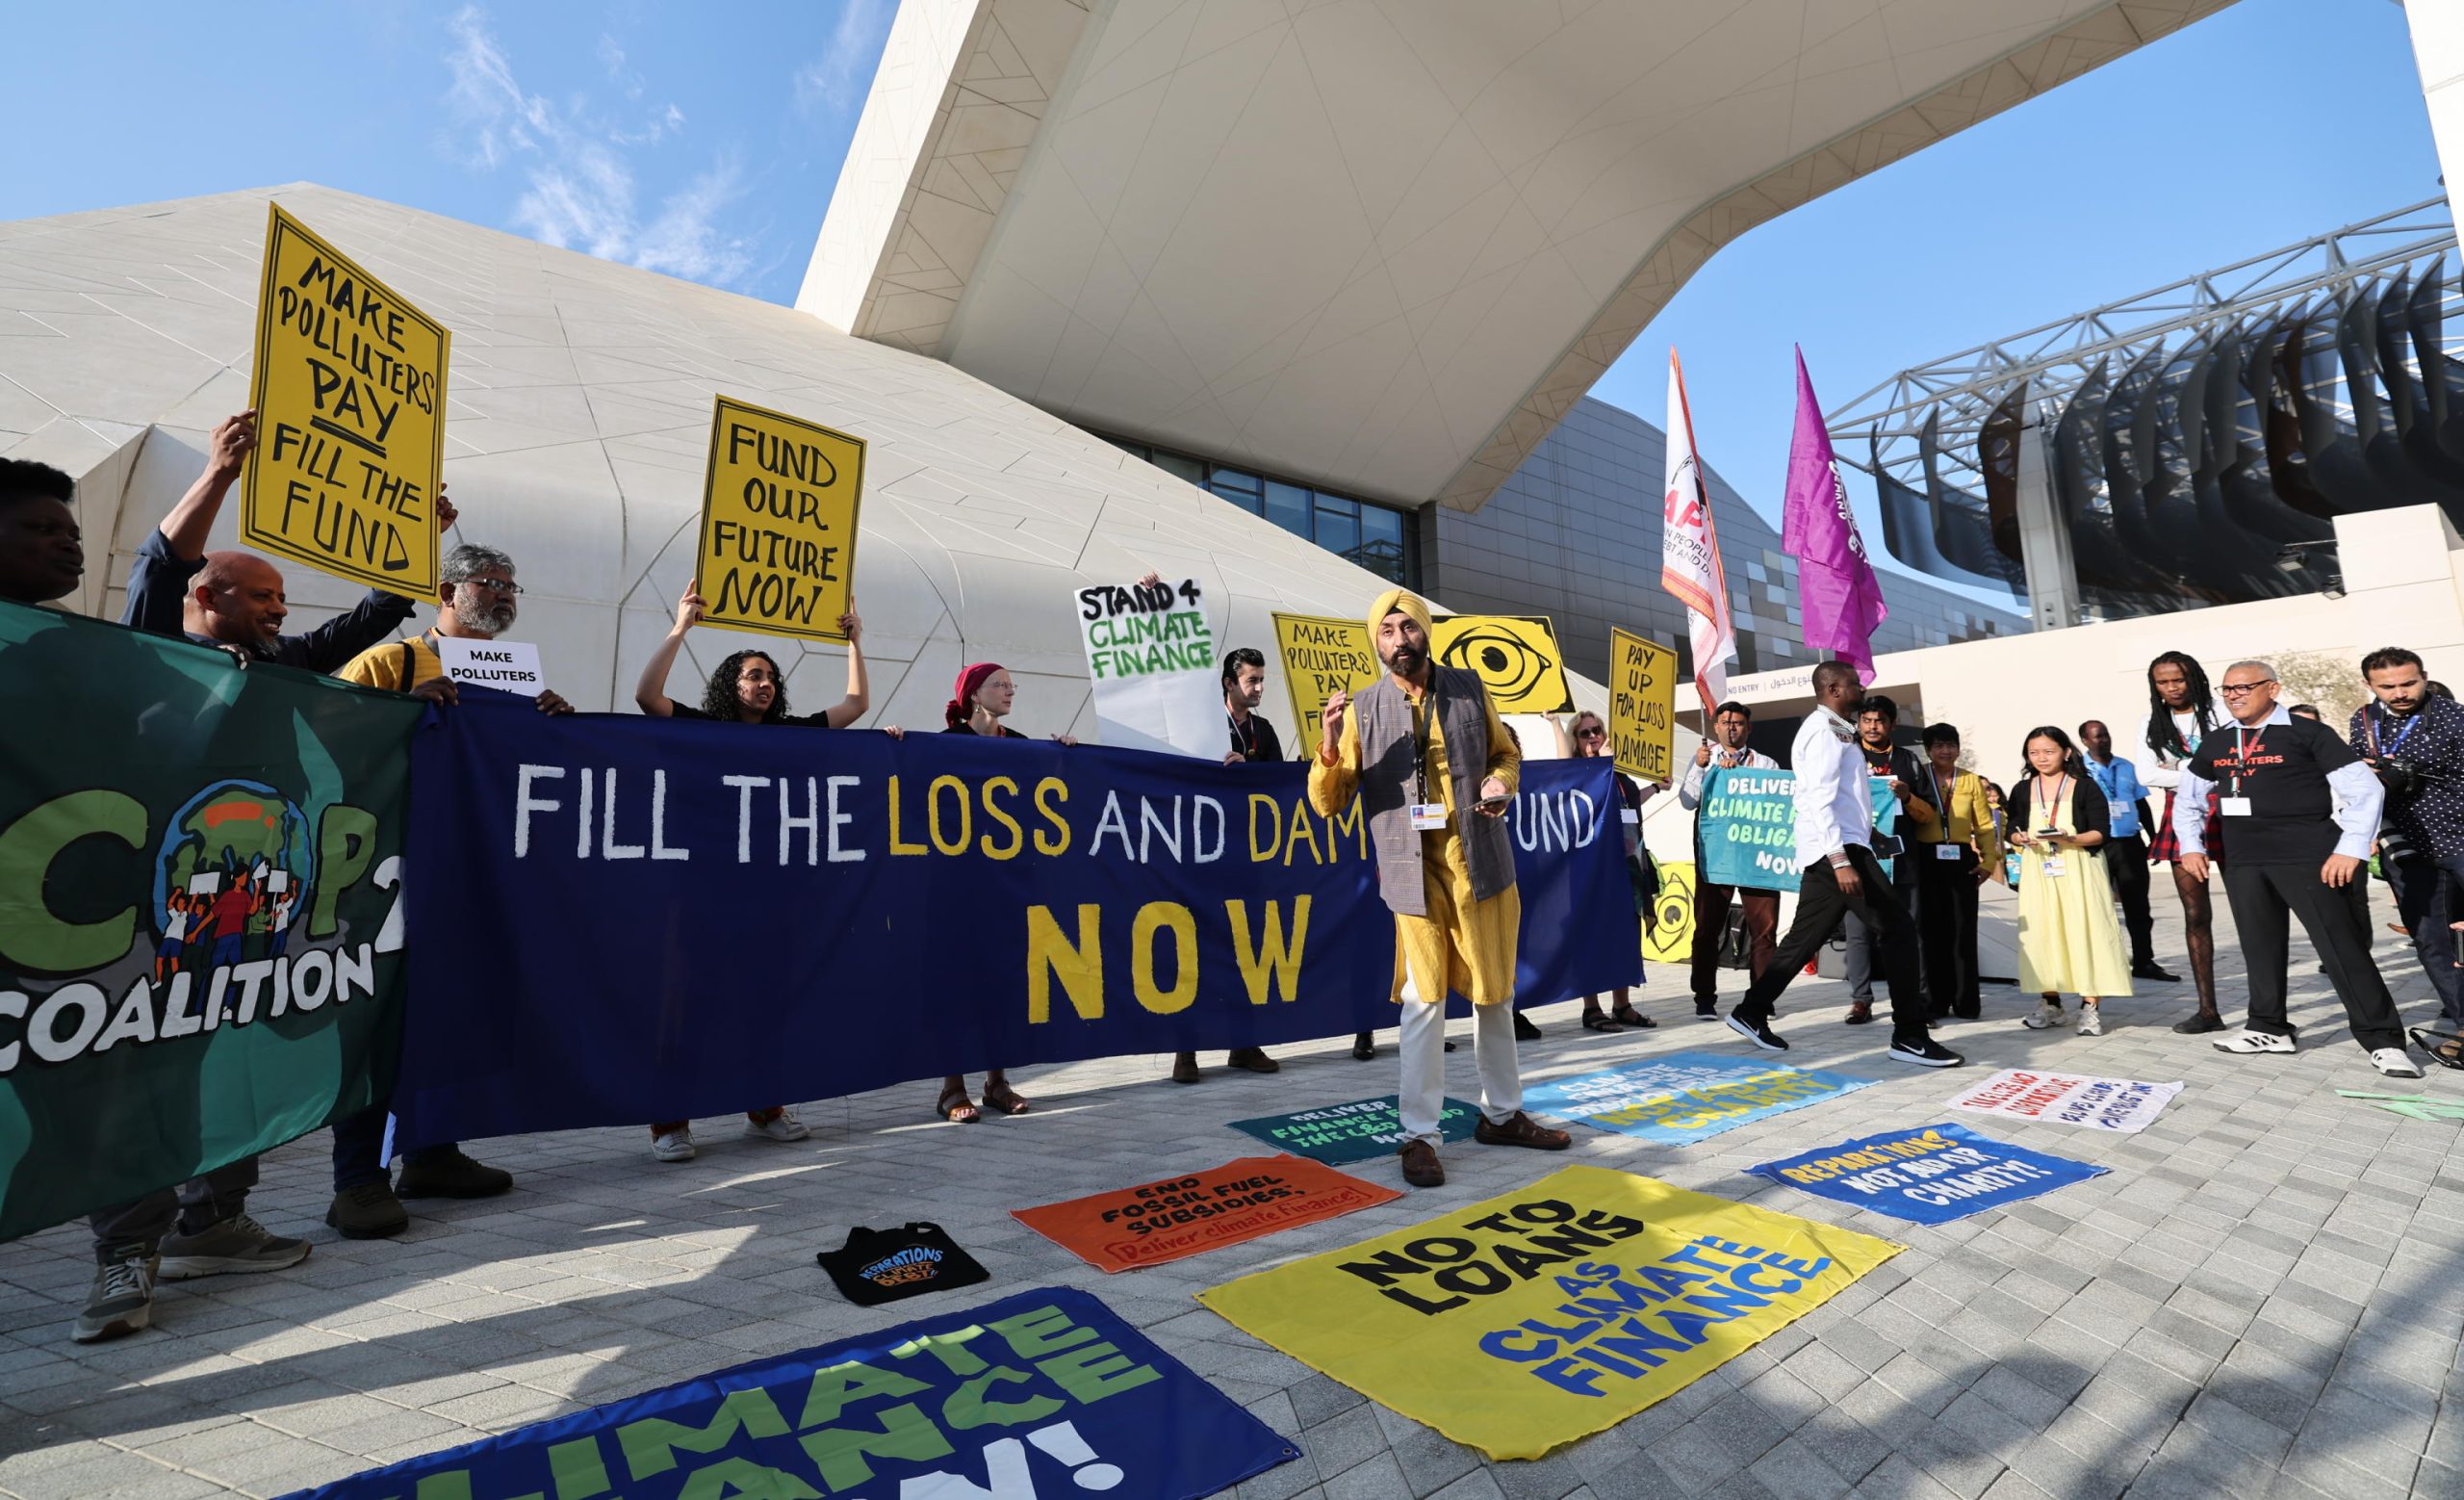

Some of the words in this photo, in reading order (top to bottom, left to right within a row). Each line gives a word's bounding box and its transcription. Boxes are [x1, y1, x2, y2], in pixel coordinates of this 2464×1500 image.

[299, 257, 405, 352] MAKE
[279, 286, 435, 415] POLLUTERS
[307, 358, 399, 442] PAY
[272, 423, 347, 489] FILL
[360, 461, 423, 522] THE
[730, 423, 837, 488] FUND
[743, 477, 829, 531] OUR
[281, 481, 409, 571] FUND
[714, 520, 838, 582] FUTURE
[712, 567, 823, 625] NOW
[1080, 585, 1174, 620] STAND
[1179, 578, 1201, 606] 4
[1089, 611, 1212, 650] CLIMATE
[1294, 623, 1351, 647] MAKE
[450, 667, 537, 683] POLLUTERS
[470, 650, 513, 663] MAKE
[1091, 640, 1216, 679] FINANCE
[1287, 647, 1372, 675] POLLUTERS
[1626, 644, 1656, 670] PAY
[1313, 673, 1351, 694] PAY
[1629, 669, 1654, 694] UP
[1738, 684, 1759, 693] ENTRY
[1304, 711, 1323, 732] FI
[1615, 693, 1635, 721] FOR
[1638, 700, 1665, 731] LOSS
[1614, 732, 1666, 774] DAMAGE
[2214, 755, 2284, 767] POLLTERS
[514, 763, 691, 861] FILL
[722, 774, 867, 866] THE
[887, 774, 1072, 861] LOSS
[1089, 789, 1226, 865] AND
[1248, 790, 1369, 866] DAM
[1503, 789, 1595, 853] UND
[1707, 797, 1784, 823] CLIMATE
[1728, 823, 1797, 848] OBLIGA
[1026, 893, 1312, 1025] NOW
[1271, 1113, 1383, 1139] FINANCE
[1290, 1100, 1393, 1122] DELIVER
[1291, 1131, 1348, 1148] THE
[1781, 1130, 1959, 1184] REPARATIONS
[1134, 1177, 1201, 1200] END
[1840, 1167, 1914, 1195] NOT
[1938, 1147, 2000, 1166] OR
[1902, 1159, 2053, 1205] CHARITY!
[1101, 1192, 1214, 1225] FOSSIL
[1213, 1174, 1285, 1198] FUEL
[1120, 1230, 1199, 1263] Deliver
[1205, 1208, 1278, 1240] climate
[1335, 1236, 1478, 1288] NO
[1461, 1198, 1578, 1236] TO
[859, 1247, 944, 1280] REPARATIONS
[872, 1261, 934, 1282] CLIMATE
[1378, 1207, 1646, 1317] LOANS
[1551, 1261, 1623, 1299] AS
[1477, 1234, 1763, 1362] CLIMATE
[1529, 1254, 1834, 1399] FINANCE
[385, 1305, 1101, 1500] LIMATE
[664, 1341, 1165, 1500] ANCE
